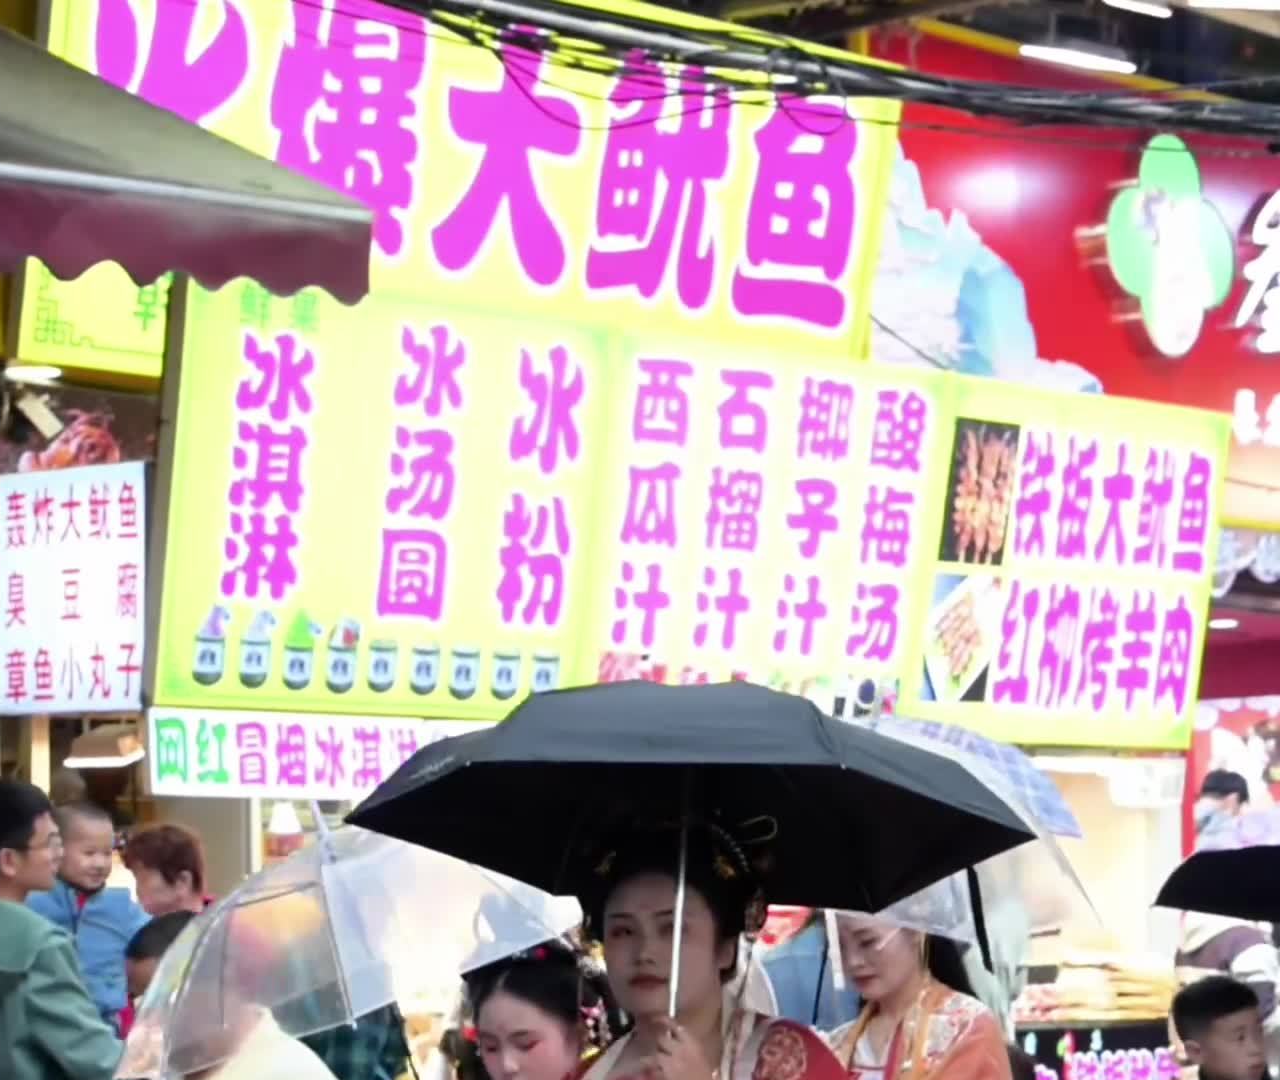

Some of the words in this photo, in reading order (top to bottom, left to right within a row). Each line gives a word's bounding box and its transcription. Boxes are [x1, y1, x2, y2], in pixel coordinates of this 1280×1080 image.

[6, 482, 139, 548] 轰炸大鱿鱼
[6, 562, 138, 628] 臭豆腐
[221, 333, 313, 600] 冰淇淋
[376, 325, 465, 621] 冰汤圆
[497, 346, 583, 625] 冰粉
[612, 358, 694, 647] 西瓜汁
[693, 369, 774, 650] 石榴汁
[773, 377, 854, 655] 椰子汁
[846, 390, 926, 661] 酸梅汤
[1015, 431, 1211, 573] 铁板大鱿鱼
[5, 642, 140, 704] 章鱼小丸子
[993, 579, 1193, 716] 红柳烤羊肉
